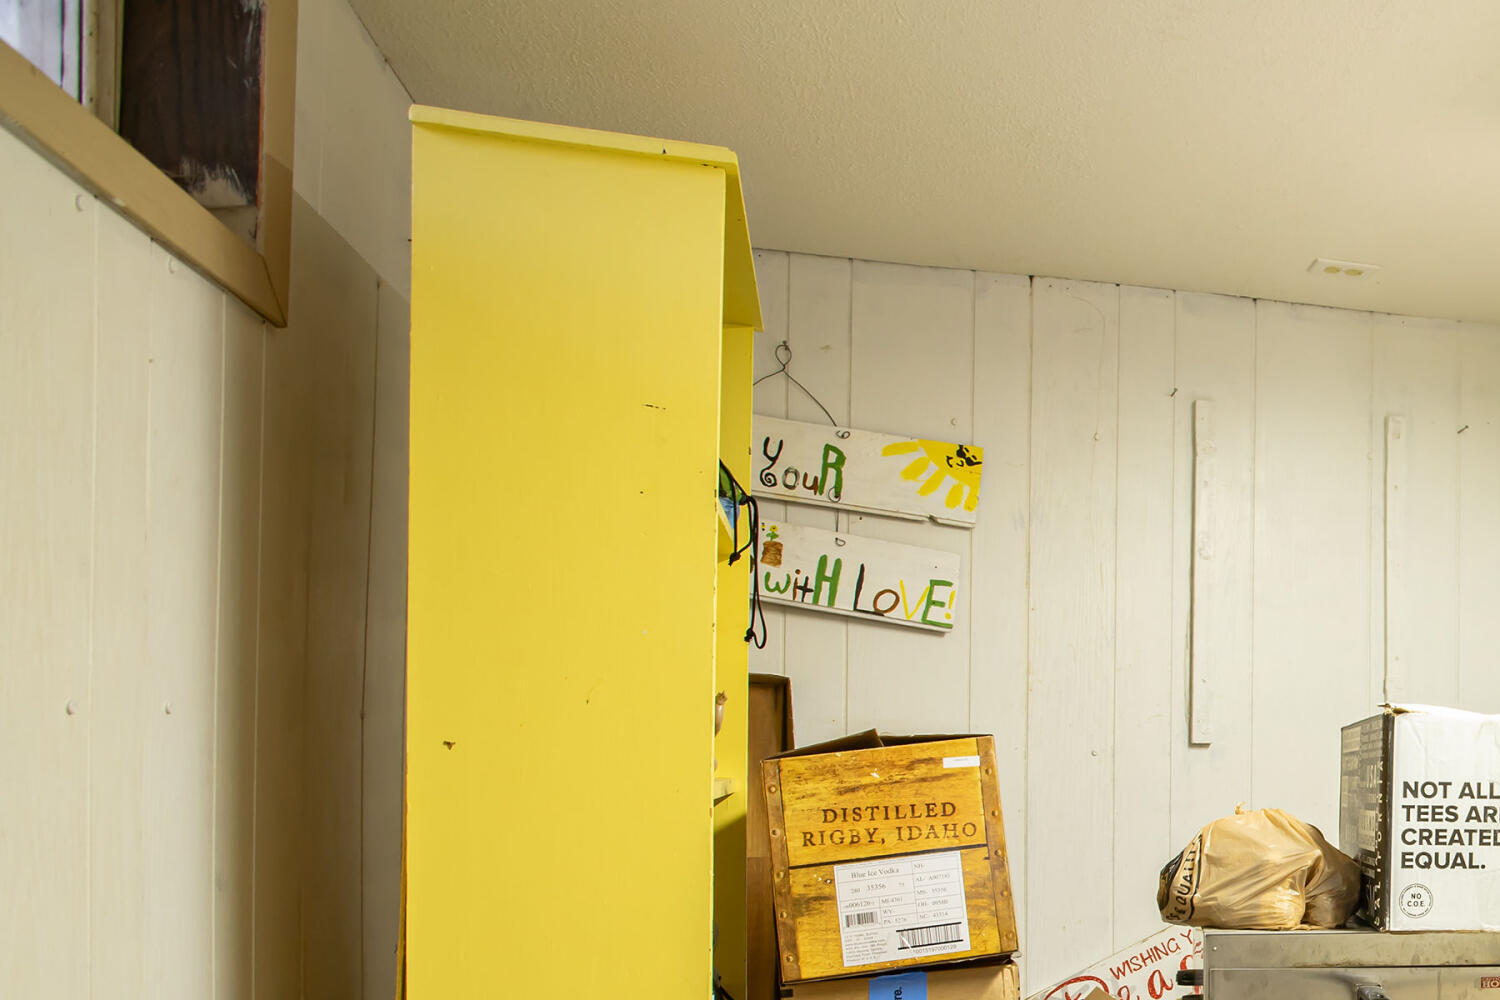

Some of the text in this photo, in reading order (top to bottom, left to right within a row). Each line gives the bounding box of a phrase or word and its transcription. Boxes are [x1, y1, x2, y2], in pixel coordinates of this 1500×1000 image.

[1402, 781, 1500, 799] NOT ALL
[822, 802, 956, 823] DISTILLED
[1402, 805, 1459, 822] TEES
[802, 822, 977, 847] RIGBY, IDAHO
[1401, 852, 1486, 869] EQUAL.
[879, 868, 899, 876] Vodka
[1110, 937, 1180, 980] WISHING
